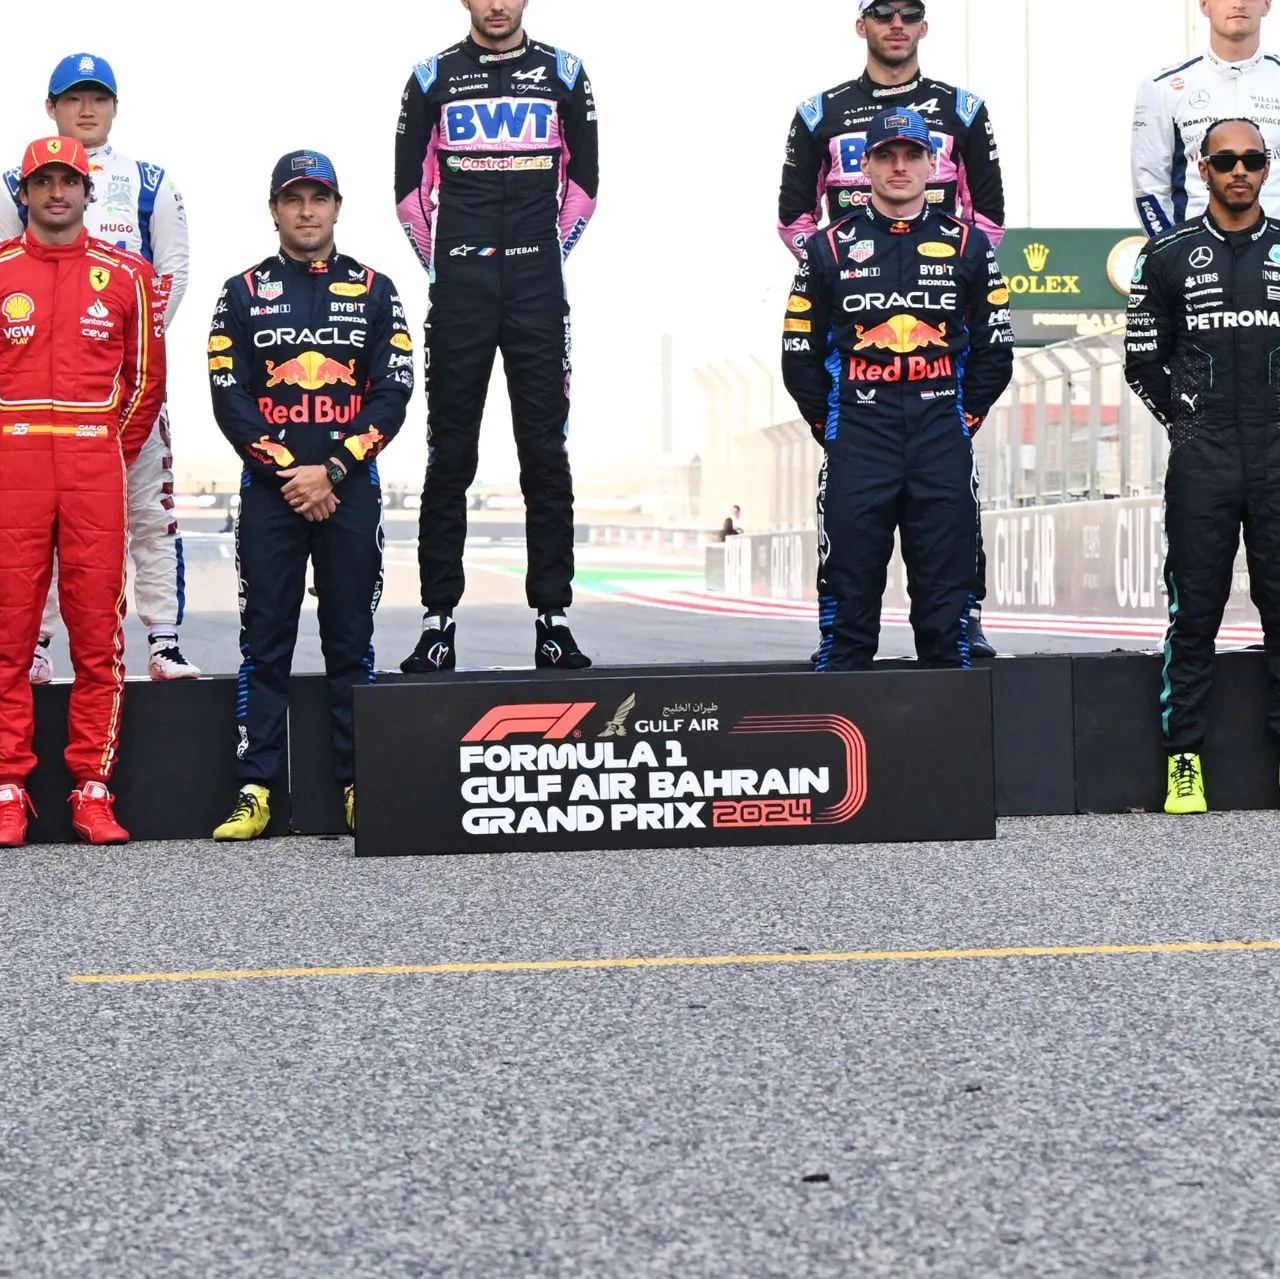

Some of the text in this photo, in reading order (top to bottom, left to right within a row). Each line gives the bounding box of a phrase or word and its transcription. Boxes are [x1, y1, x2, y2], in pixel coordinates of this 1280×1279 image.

[449, 73, 488, 82] ALPINE
[843, 105, 883, 114] ALPINE
[447, 102, 553, 142] BWT
[460, 157, 513, 170] Castrol
[111, 175, 130, 183] VISA
[100, 224, 133, 233] HUGO
[505, 245, 539, 256] ESTEBAN
[840, 268, 868, 280] Mobil
[920, 264, 954, 276] BYBIT
[918, 279, 956, 287] HONDA
[1196, 272, 1218, 284] UBS
[330, 302, 365, 313] BYBIT
[842, 292, 956, 312] ORACLE
[250, 307, 279, 316] Mobil
[79, 316, 114, 327] Santander
[329, 316, 367, 324] HONDA
[2, 325, 35, 337] VGW
[254, 328, 367, 347] ORACLE
[783, 338, 810, 352] VISA
[1127, 340, 1157, 351] nuvei
[848, 356, 952, 381] Red Bull
[259, 394, 362, 425] Red Bull
[11, 423, 29, 435] 55
[994, 513, 1056, 607] GULF AIR
[1115, 507, 1161, 608] GULF
[634, 719, 719, 733] GULF AIR
[460, 740, 688, 774] FORMULA 1
[460, 766, 830, 805] GULF AIR BAHRAIN
[460, 799, 812, 835] GRAND PRIX 2024
